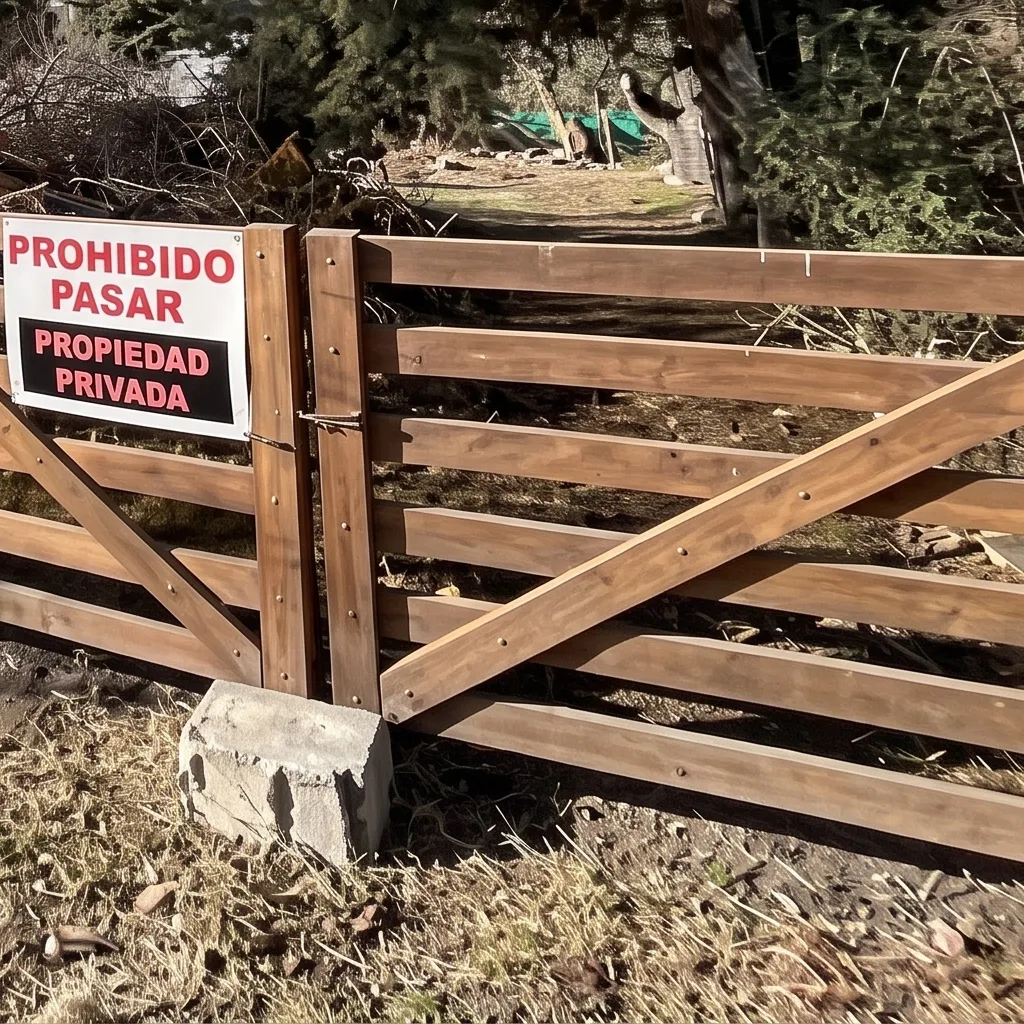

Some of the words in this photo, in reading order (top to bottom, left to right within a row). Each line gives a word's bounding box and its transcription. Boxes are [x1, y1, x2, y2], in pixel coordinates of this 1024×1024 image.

[9, 235, 235, 284] PROHIBIDO
[51, 279, 184, 324] PASAR
[34, 329, 210, 377] PROPIEDAD
[55, 367, 190, 413] PRIVADA
